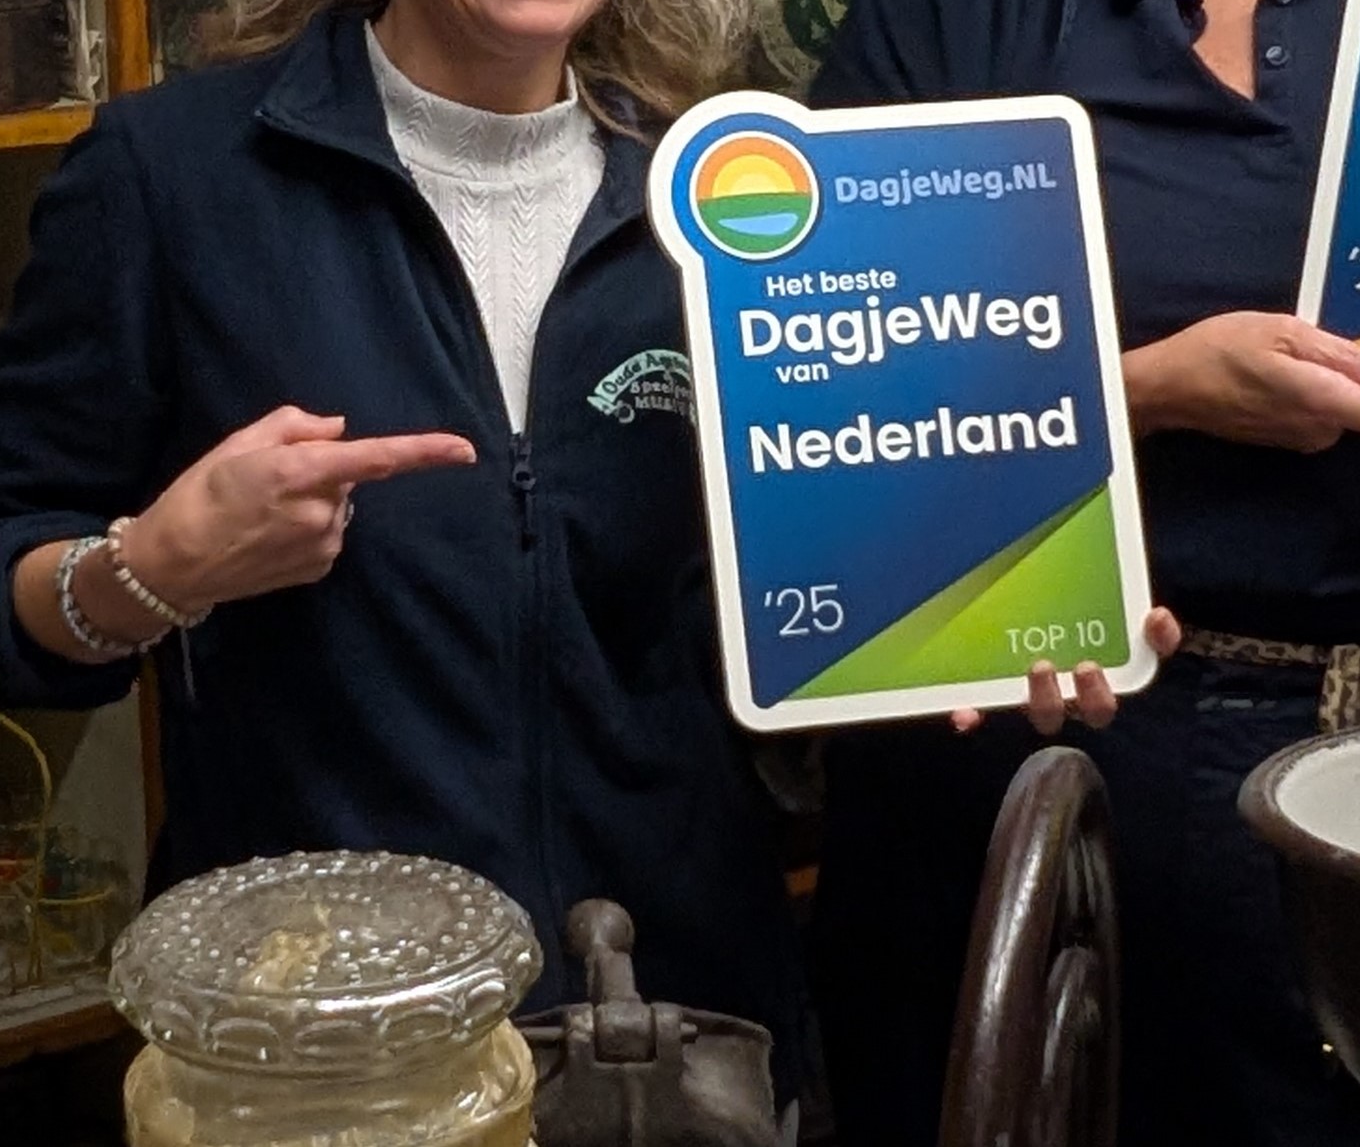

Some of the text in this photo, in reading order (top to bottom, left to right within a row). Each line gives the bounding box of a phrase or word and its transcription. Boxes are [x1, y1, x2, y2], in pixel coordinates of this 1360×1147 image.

[833, 162, 1057, 208] DagjeWeg.NL
[766, 267, 897, 298] Het beste
[739, 292, 1063, 368] DagjeWeg
[601, 360, 643, 394] Oude
[775, 359, 829, 386] van
[748, 395, 1078, 474] Nederland
[763, 584, 844, 638] '25
[1006, 618, 1106, 655] TOP 10
